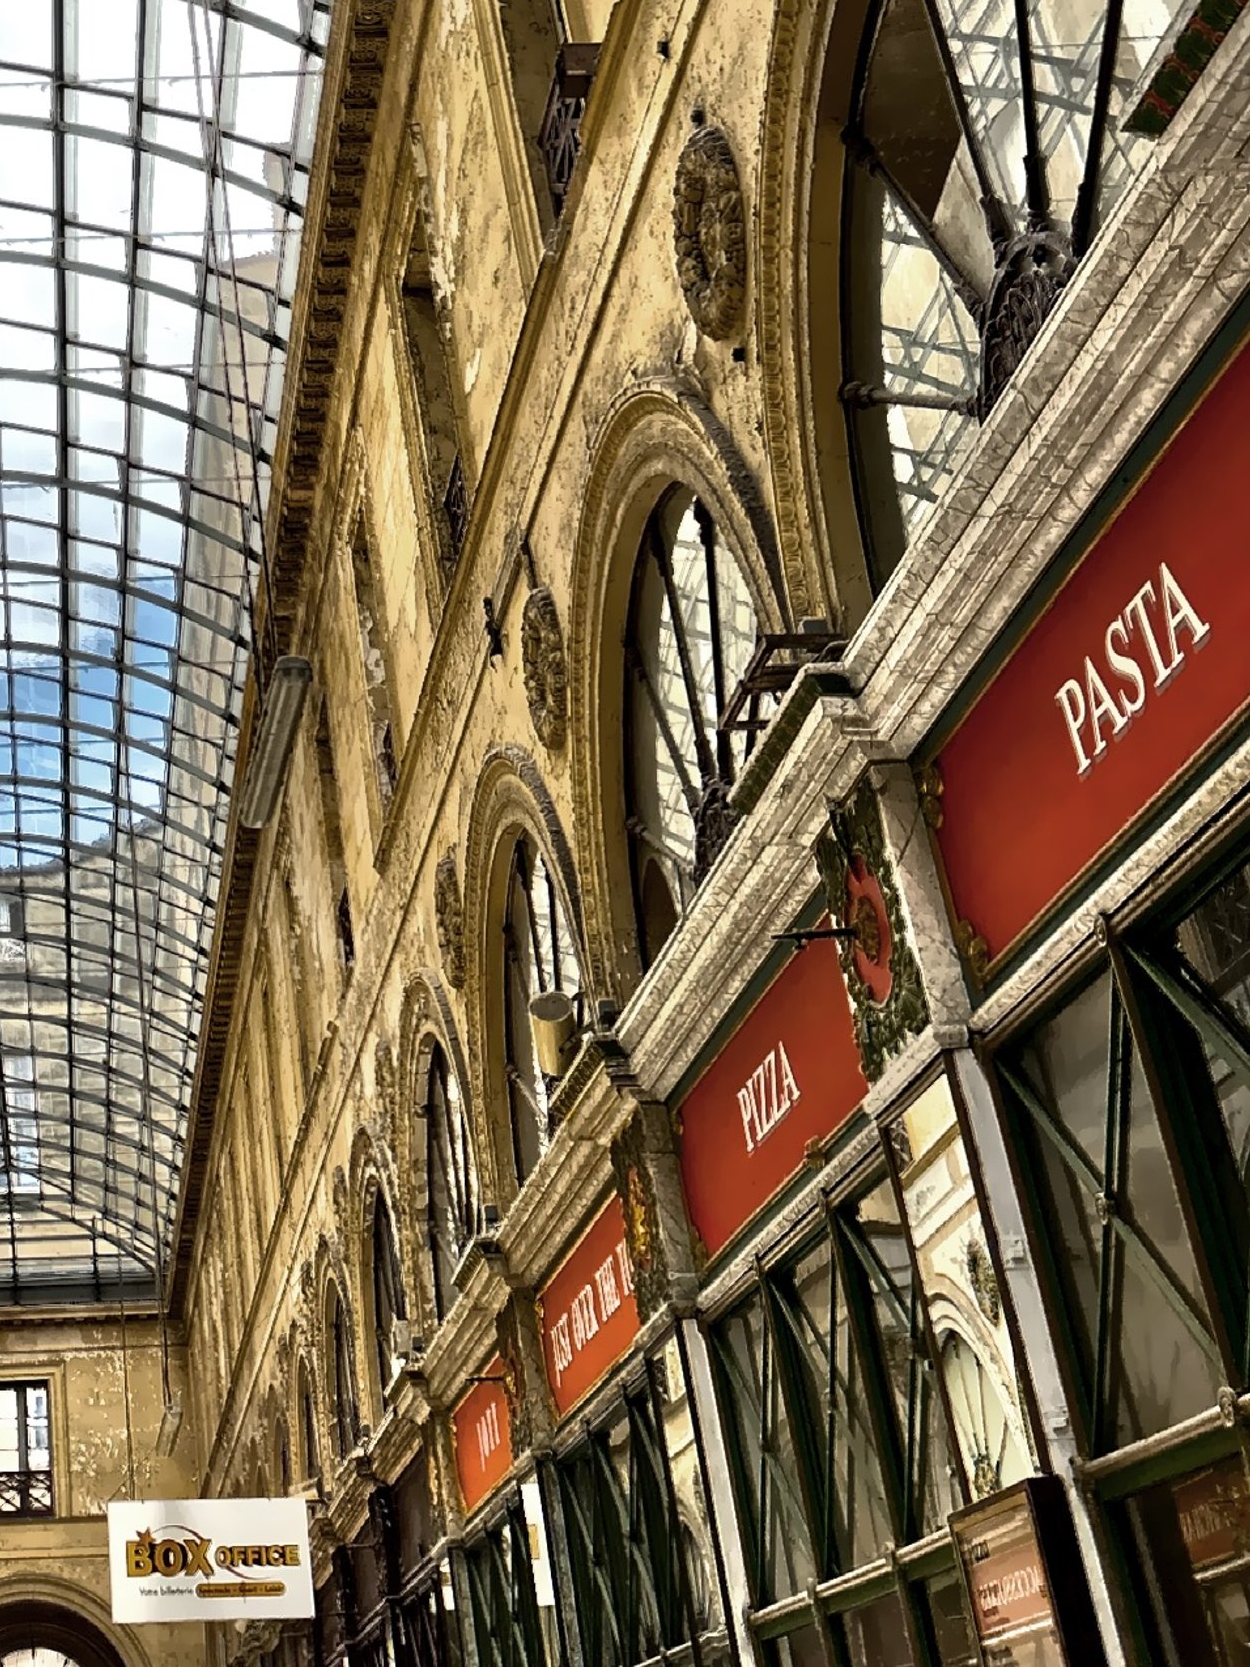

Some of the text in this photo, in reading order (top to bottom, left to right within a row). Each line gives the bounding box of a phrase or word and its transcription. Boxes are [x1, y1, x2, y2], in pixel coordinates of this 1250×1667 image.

[1054, 562, 1210, 775] PASTA
[736, 1040, 801, 1153] PIZZA
[551, 1312, 573, 1387] JUST
[571, 1284, 599, 1351] OVER
[594, 1254, 621, 1323] THE
[126, 1537, 301, 1578] BOX OFFICE
